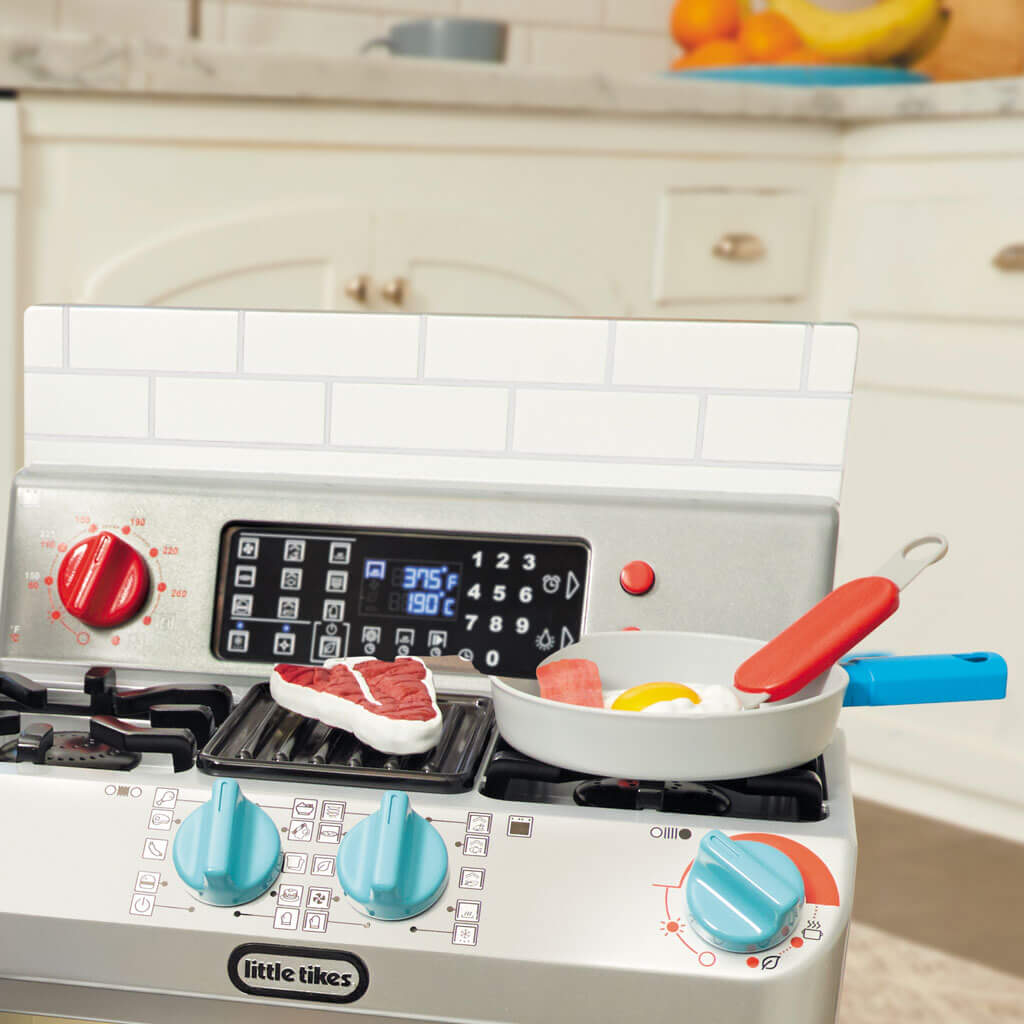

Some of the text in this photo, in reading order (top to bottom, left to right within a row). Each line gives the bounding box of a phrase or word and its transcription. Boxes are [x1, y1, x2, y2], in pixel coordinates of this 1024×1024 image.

[130, 517, 145, 527] 190
[162, 547, 179, 556] 220
[472, 551, 536, 571] 1 2 3
[171, 589, 187, 598] 260
[467, 583, 533, 603] 4 5 6
[465, 614, 529, 634] 7 8 9
[486, 650, 499, 667] 0
[244, 959, 353, 987] little tikes
